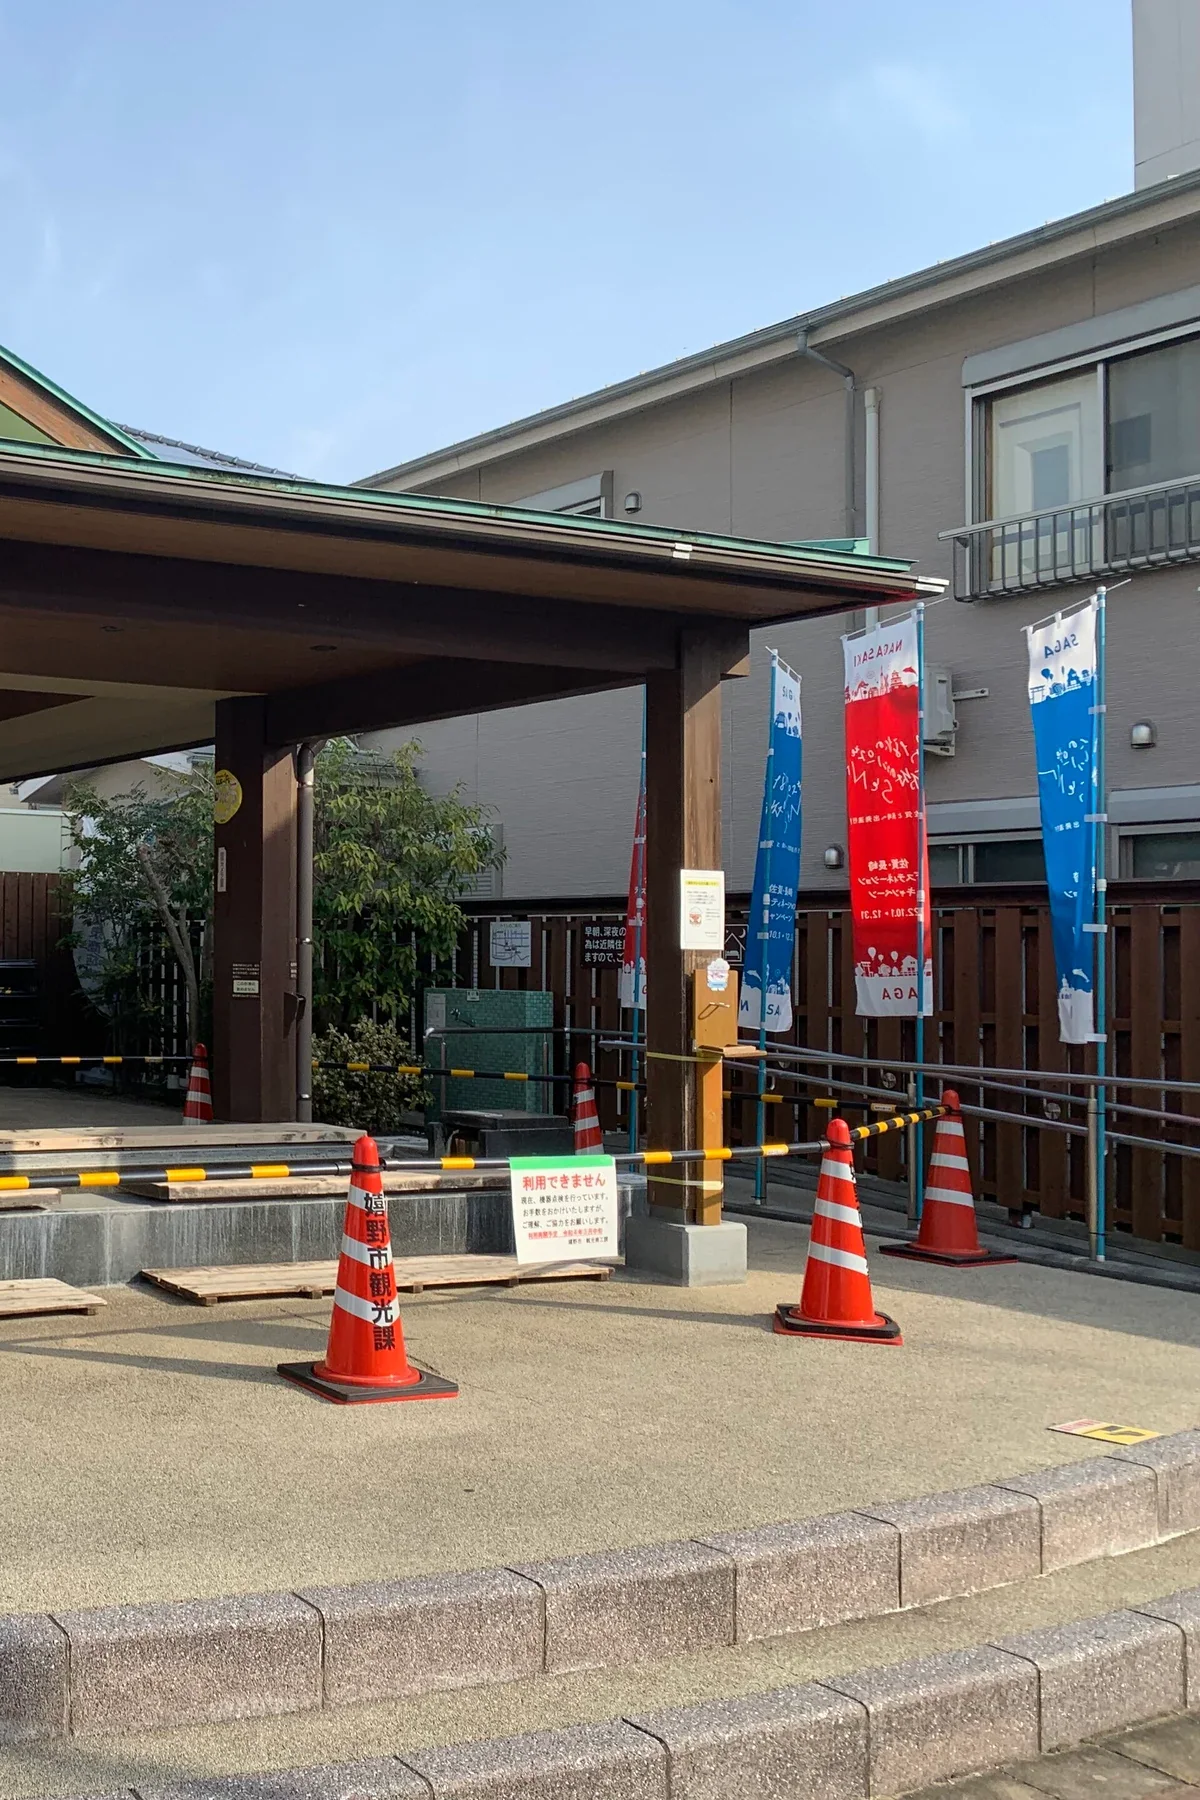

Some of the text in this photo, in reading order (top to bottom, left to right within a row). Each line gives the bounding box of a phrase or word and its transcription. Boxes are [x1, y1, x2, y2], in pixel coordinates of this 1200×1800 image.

[584, 926, 627, 937] 早朝、深夜の
[584, 939, 626, 950] 為は近隣住
[522, 1173, 606, 1191] 利用できません
[521, 1192, 609, 1205] 現在、機器点検を行っています。
[523, 1204, 605, 1217] お手数をおかけいたしますが、
[522, 1217, 609, 1229] ご理解、ご協力をお願いします。
[364, 1193, 396, 1351] 嬉野市観光課
